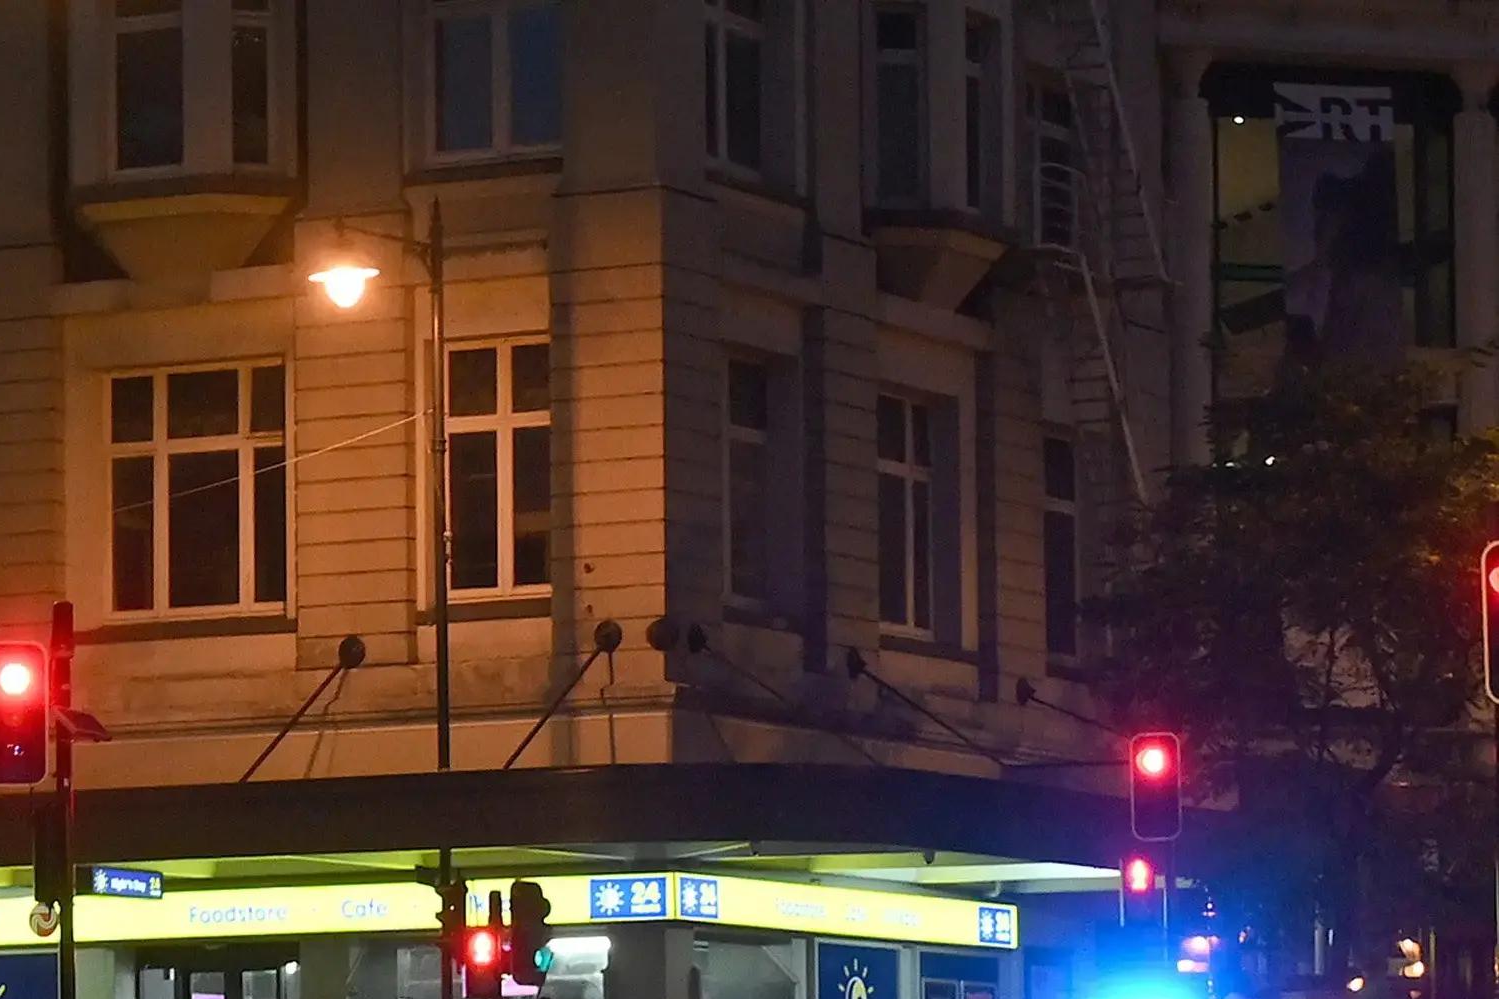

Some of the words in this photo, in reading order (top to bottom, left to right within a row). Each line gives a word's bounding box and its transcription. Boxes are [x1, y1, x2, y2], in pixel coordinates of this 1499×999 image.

[631, 881, 661, 905] 24
[188, 905, 288, 923] Foodstore
[341, 898, 388, 919] Cafe
